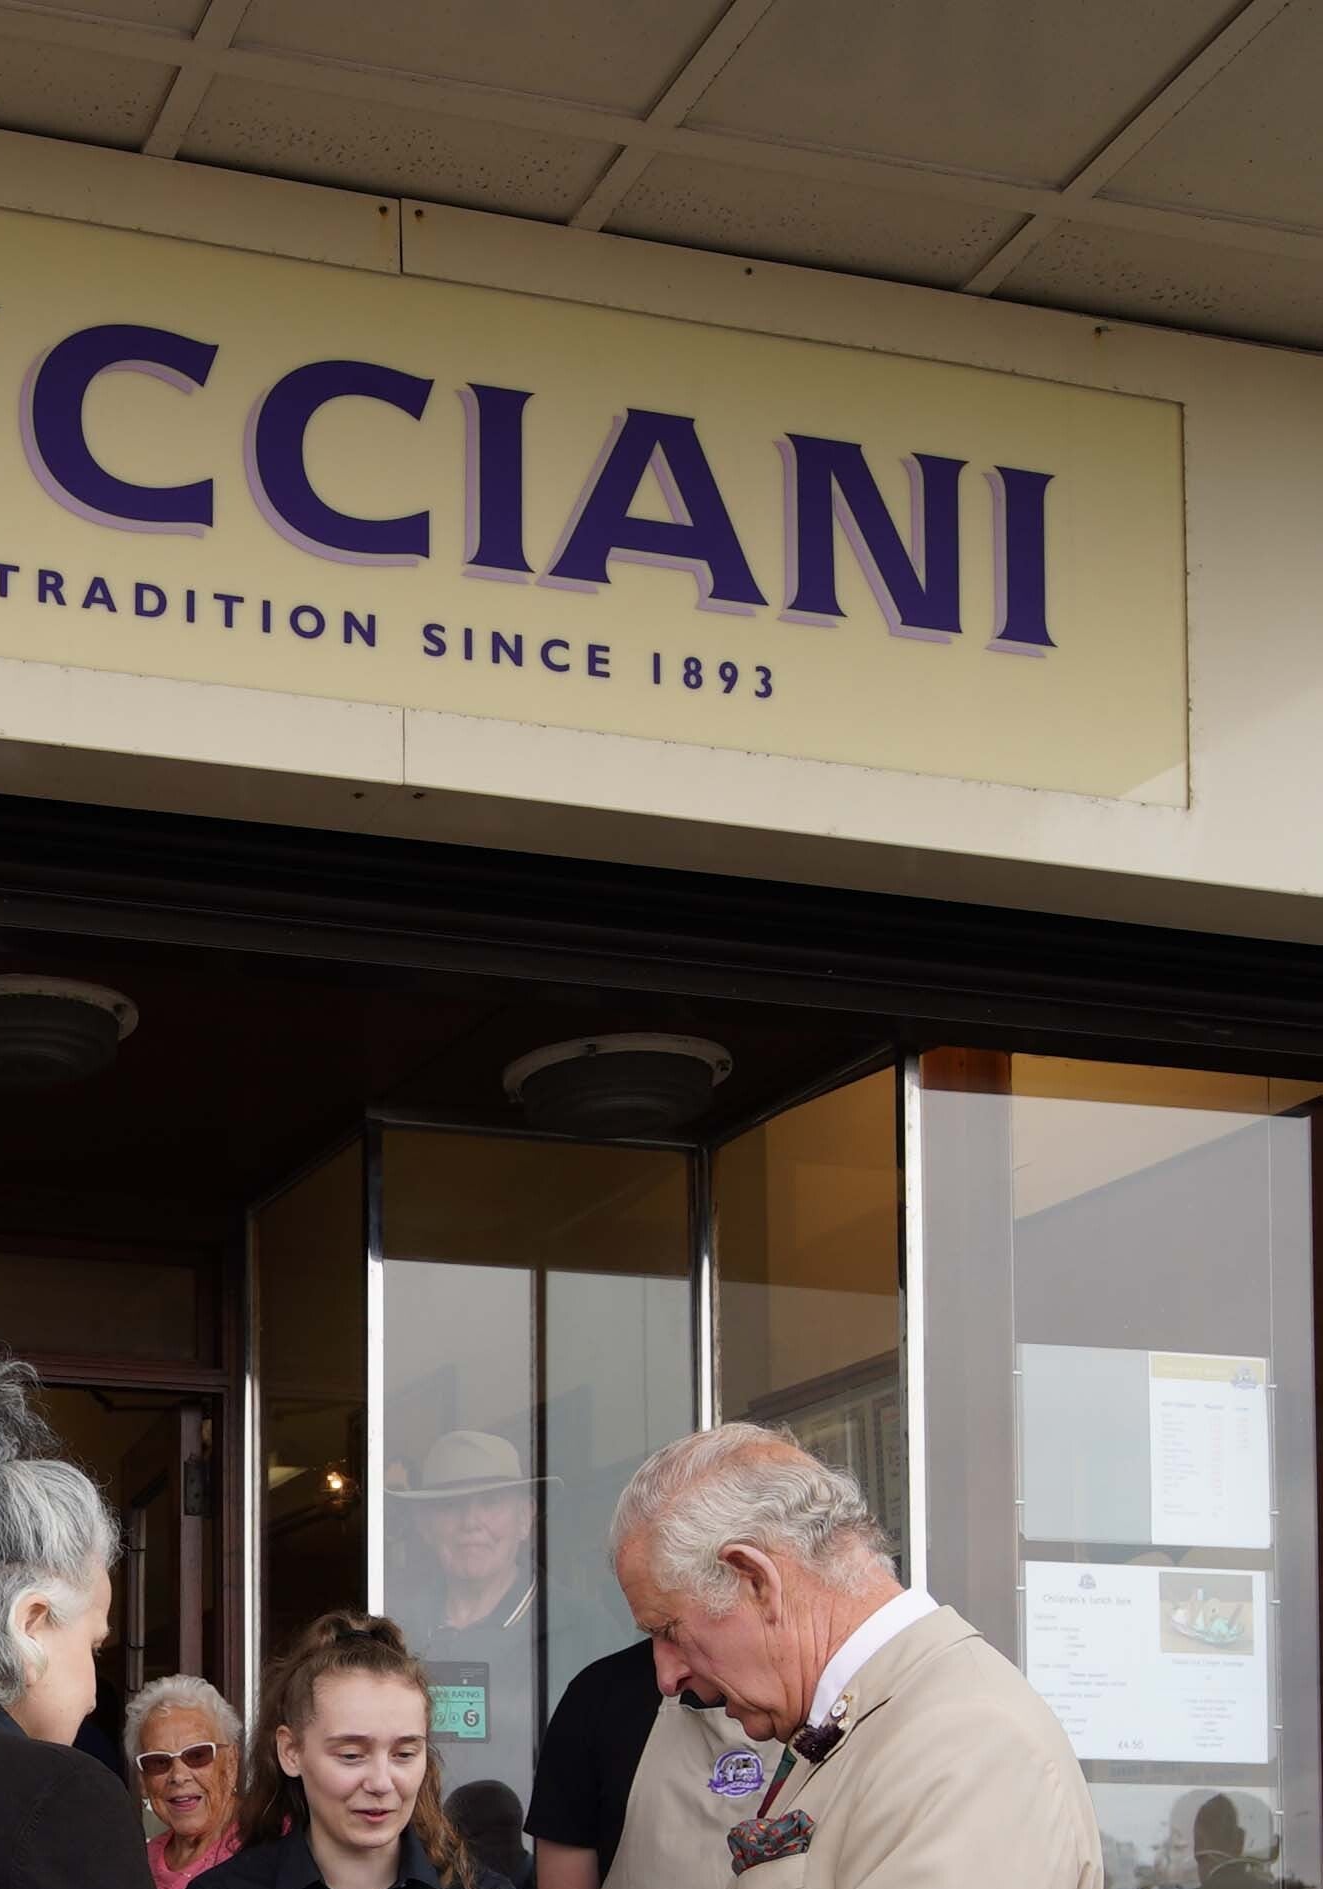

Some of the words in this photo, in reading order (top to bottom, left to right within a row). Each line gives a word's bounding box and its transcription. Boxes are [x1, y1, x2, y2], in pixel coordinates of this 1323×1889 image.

[421, 622, 613, 680] SINCE
[651, 652, 776, 700] 1893
[467, 1711, 477, 1726] 5
